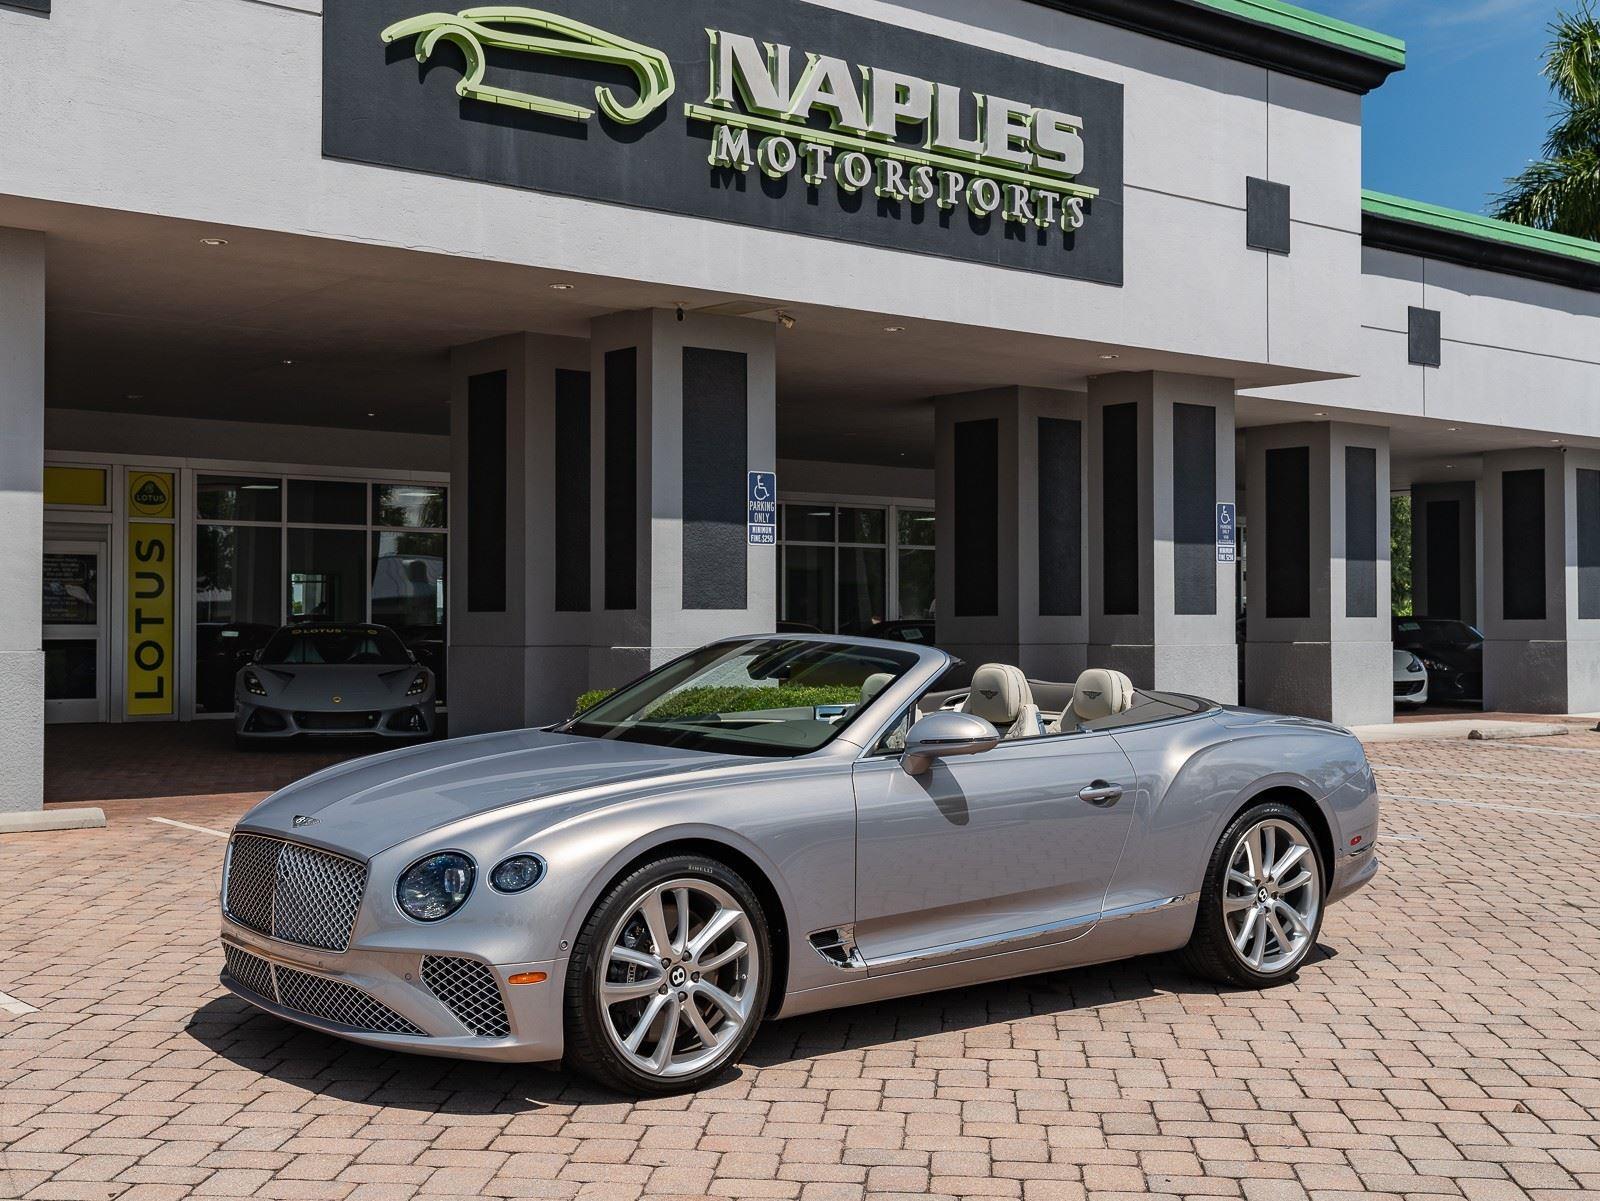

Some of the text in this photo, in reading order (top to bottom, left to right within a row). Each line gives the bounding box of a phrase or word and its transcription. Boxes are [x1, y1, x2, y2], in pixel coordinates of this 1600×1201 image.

[705, 28, 1084, 178] NAPLES
[708, 124, 1085, 231] MOTORSPORTS
[136, 494, 165, 502] LOTUS
[749, 501, 775, 512] PARKING
[754, 513, 770, 523] ONLY
[750, 534, 761, 542] FINE
[134, 539, 165, 699] LOTUS
[672, 968, 685, 984] B
